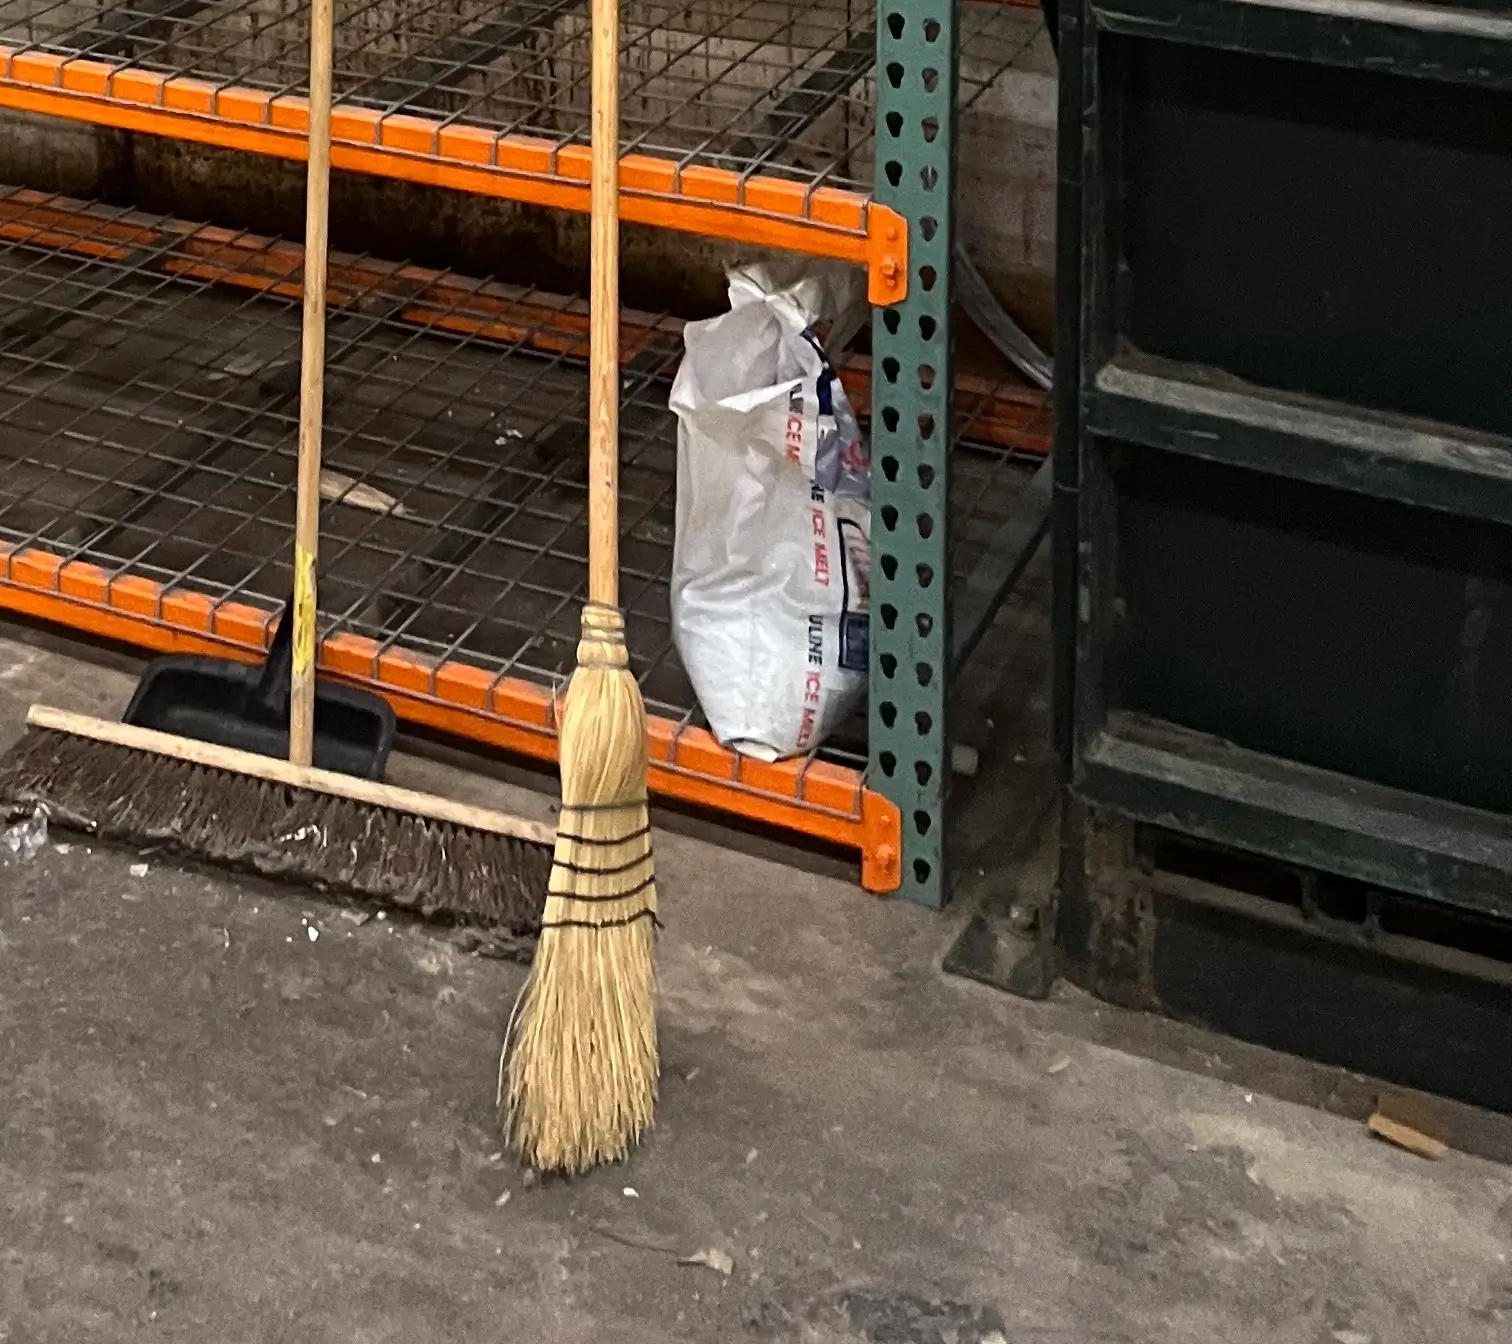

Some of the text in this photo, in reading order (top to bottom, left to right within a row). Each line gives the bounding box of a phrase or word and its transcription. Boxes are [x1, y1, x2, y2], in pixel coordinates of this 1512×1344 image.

[811, 508, 825, 538] ICE
[815, 543, 829, 588] MELT
[808, 615, 824, 666] ULINE
[805, 672, 821, 703] ICE
